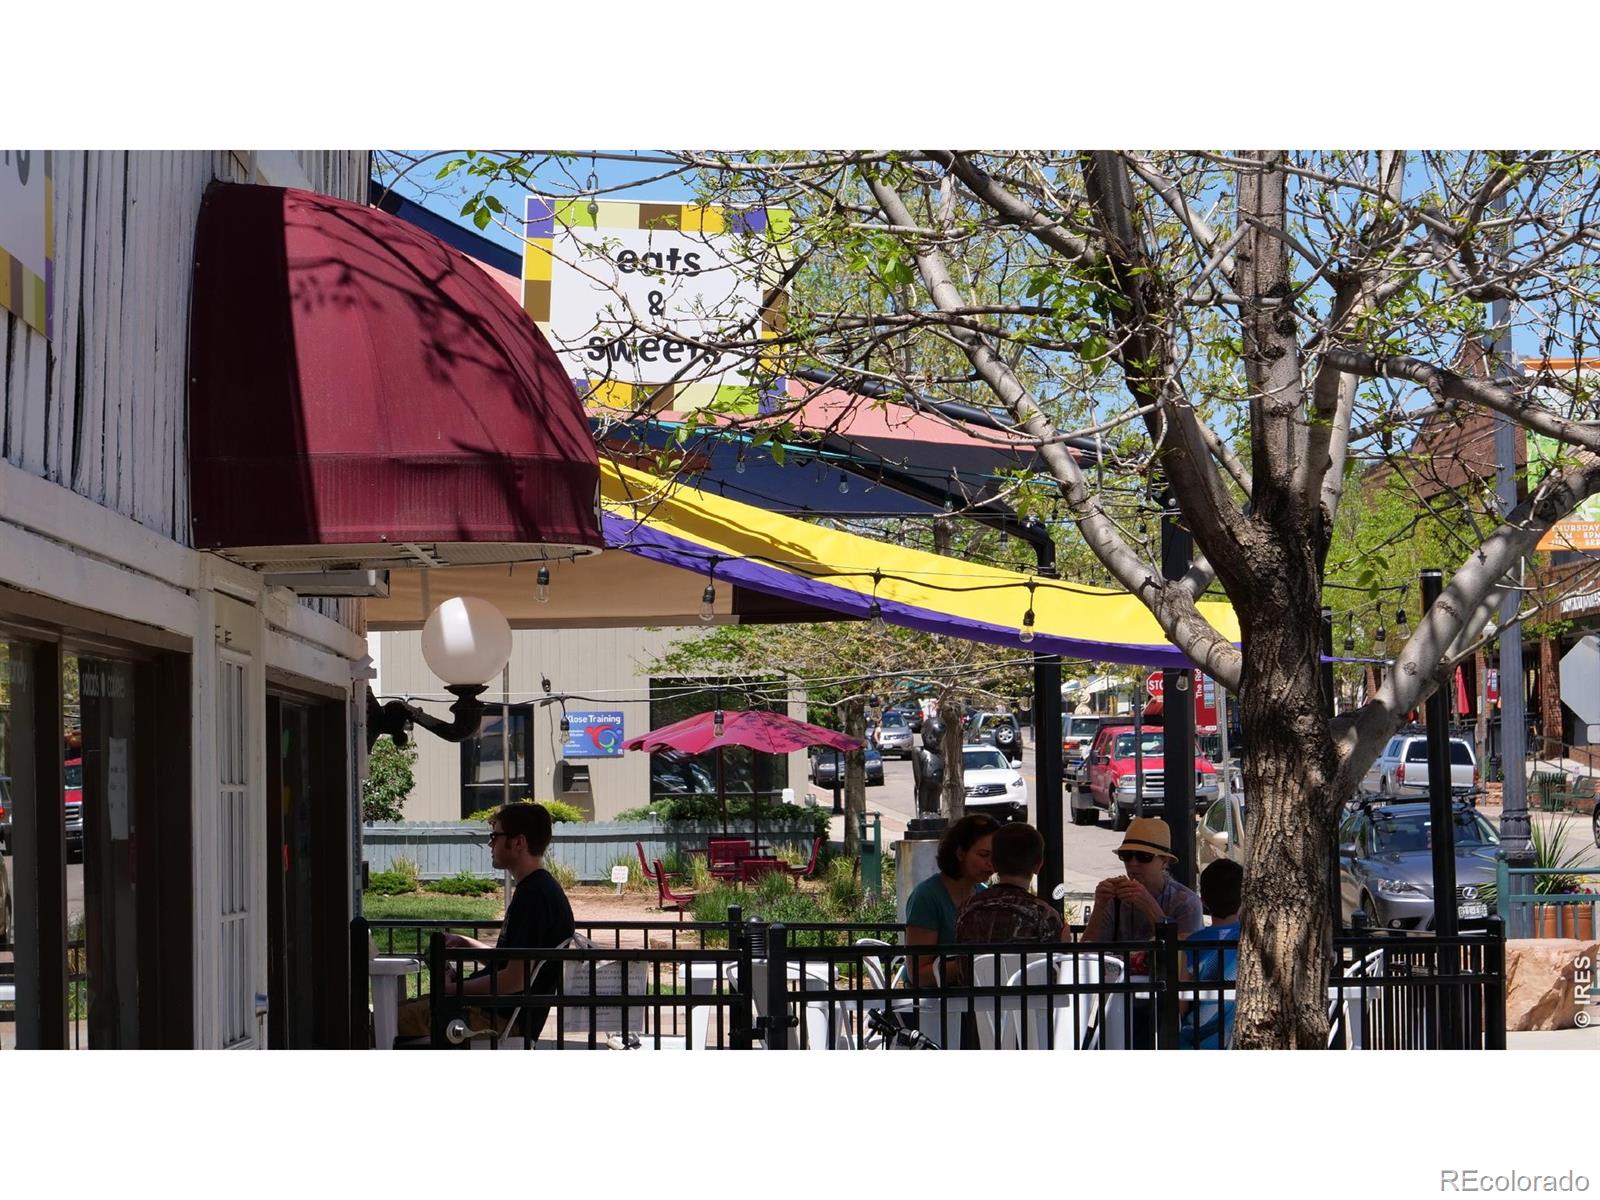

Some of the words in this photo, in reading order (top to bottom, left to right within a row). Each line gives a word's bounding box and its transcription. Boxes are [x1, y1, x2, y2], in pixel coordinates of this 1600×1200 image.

[617, 248, 701, 277] eats
[648, 290, 665, 317] &
[1194, 668, 1202, 682] Rid
[1148, 679, 1164, 691] STO
[588, 714, 621, 724] Training
